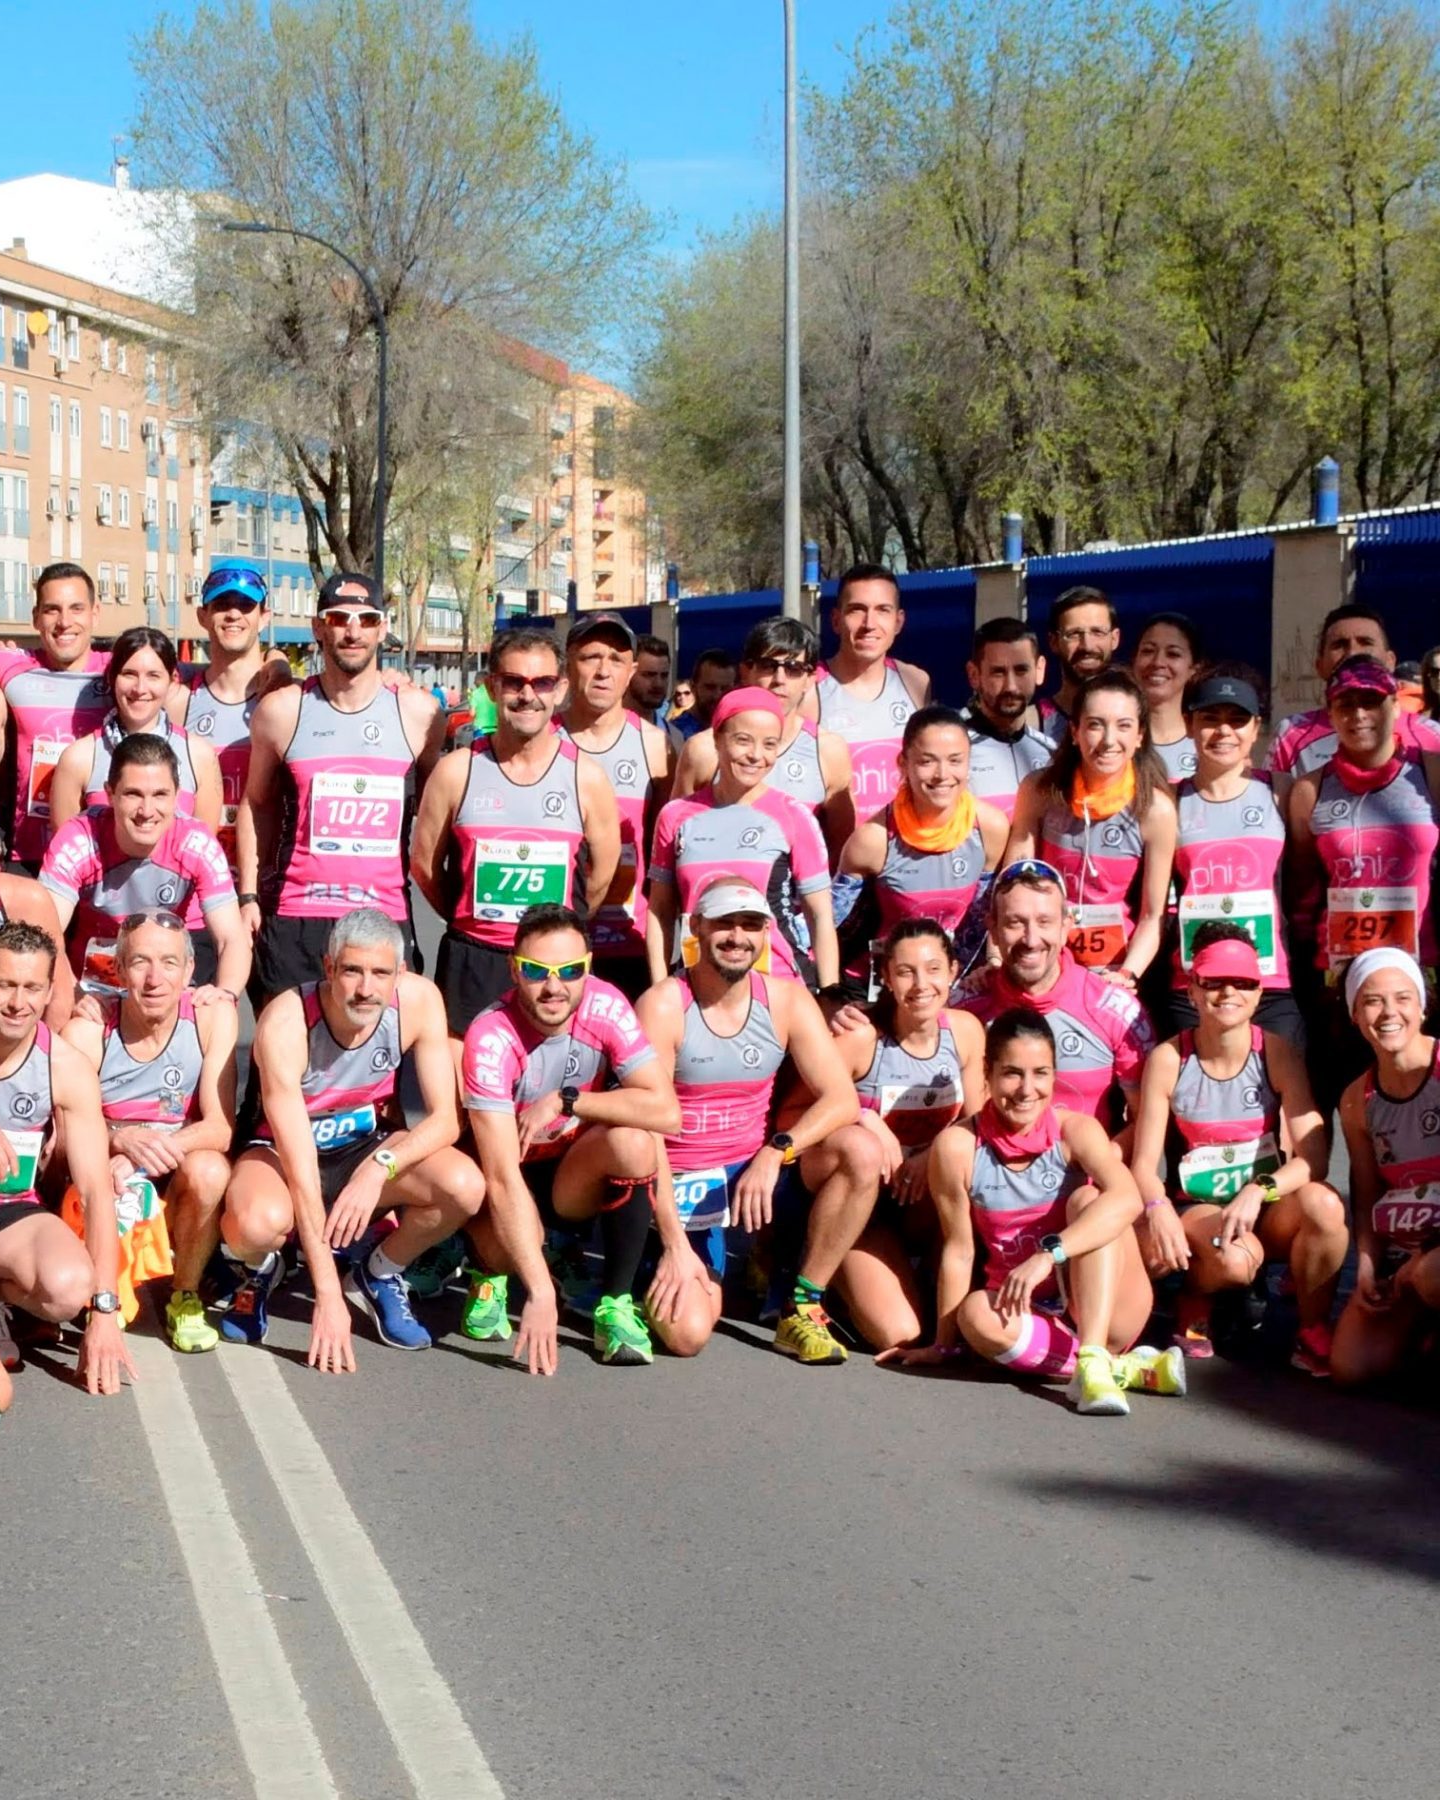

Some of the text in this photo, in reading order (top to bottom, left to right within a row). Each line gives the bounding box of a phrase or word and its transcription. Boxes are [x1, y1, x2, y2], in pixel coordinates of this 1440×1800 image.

[327, 800, 389, 826] 1072
[497, 867, 546, 892] 775
[1343, 916, 1395, 941] 297
